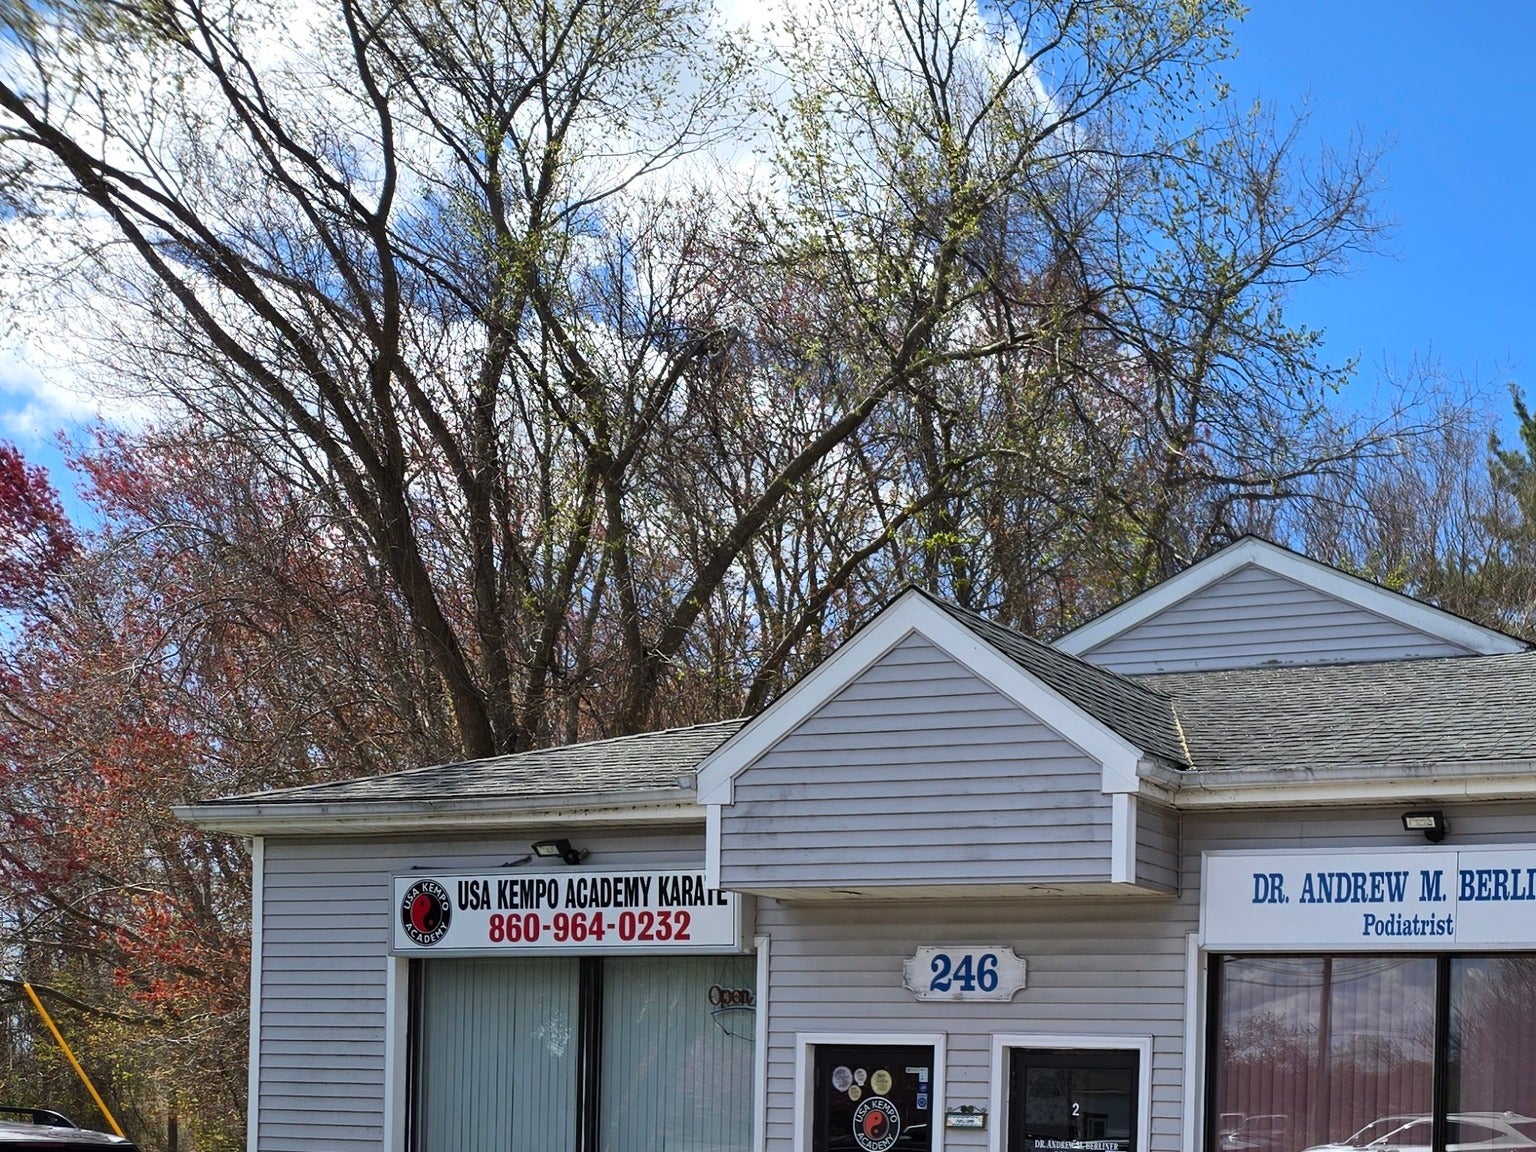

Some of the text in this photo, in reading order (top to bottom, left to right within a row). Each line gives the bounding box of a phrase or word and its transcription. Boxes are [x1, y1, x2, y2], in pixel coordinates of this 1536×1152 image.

[403, 882, 449, 911] USA KEMPO
[457, 879, 492, 911] USA
[497, 878, 559, 910] KEMPO
[565, 876, 652, 909] ACADEMY
[1252, 872, 1290, 904] DR.
[1299, 870, 1410, 904] ANDREW
[1419, 870, 1447, 902] M.
[405, 921, 448, 944] ACADEMY
[488, 910, 692, 943] 860-964-0232
[1362, 912, 1454, 936] Podiatrist
[929, 953, 999, 992] 246
[708, 985, 752, 1008] Open
[855, 1100, 898, 1124] USA KEMPO
[1072, 1103, 1080, 1116] 2
[857, 1131, 894, 1150] ACADEMY
[1047, 1139, 1074, 1149] ANDREW
[1085, 1141, 1119, 1151] BERLINER
